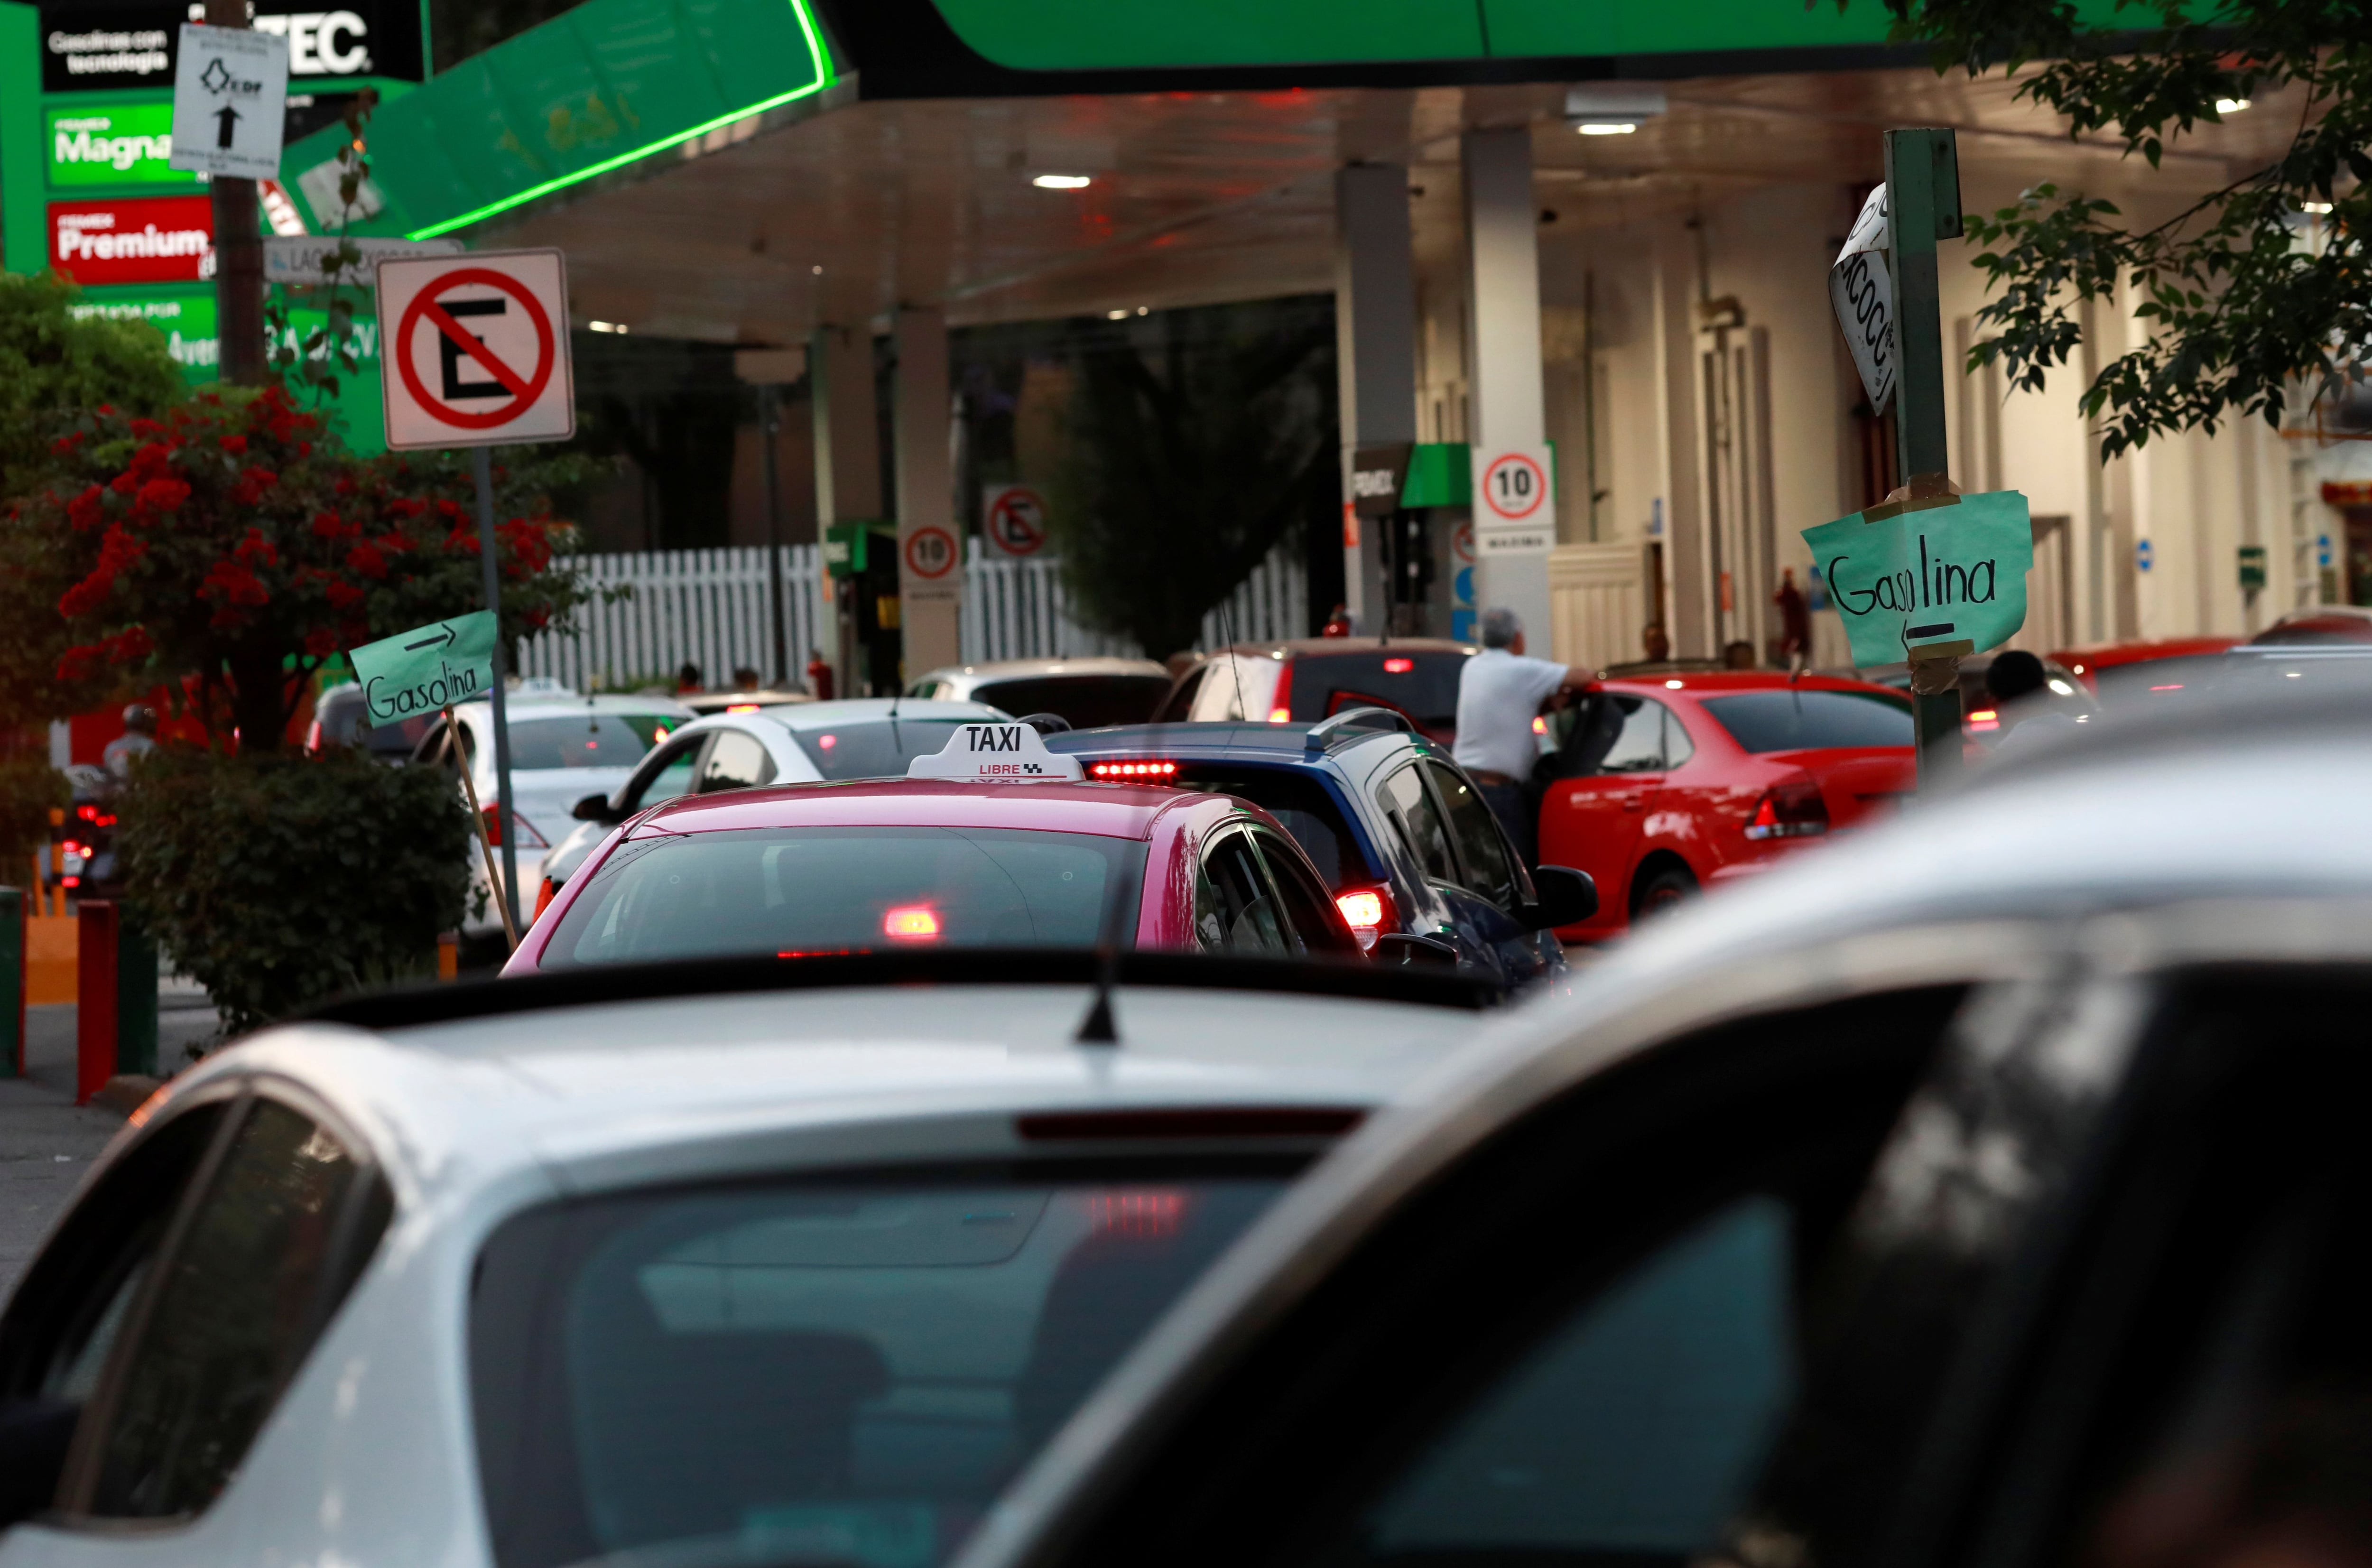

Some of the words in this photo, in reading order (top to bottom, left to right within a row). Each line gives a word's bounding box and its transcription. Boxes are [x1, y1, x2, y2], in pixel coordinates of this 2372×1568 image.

[49, 30, 130, 53] Gasolinas
[132, 30, 167, 49] con
[55, 130, 172, 170] Magna
[58, 223, 209, 260] Premium
[1495, 468, 1531, 496] 10
[917, 538, 945, 560] 10
[1828, 534, 1996, 615] Gasolina
[366, 661, 476, 718] Gasolina
[966, 727, 1021, 752] TAXI
[980, 764, 1020, 774] LIBRE
